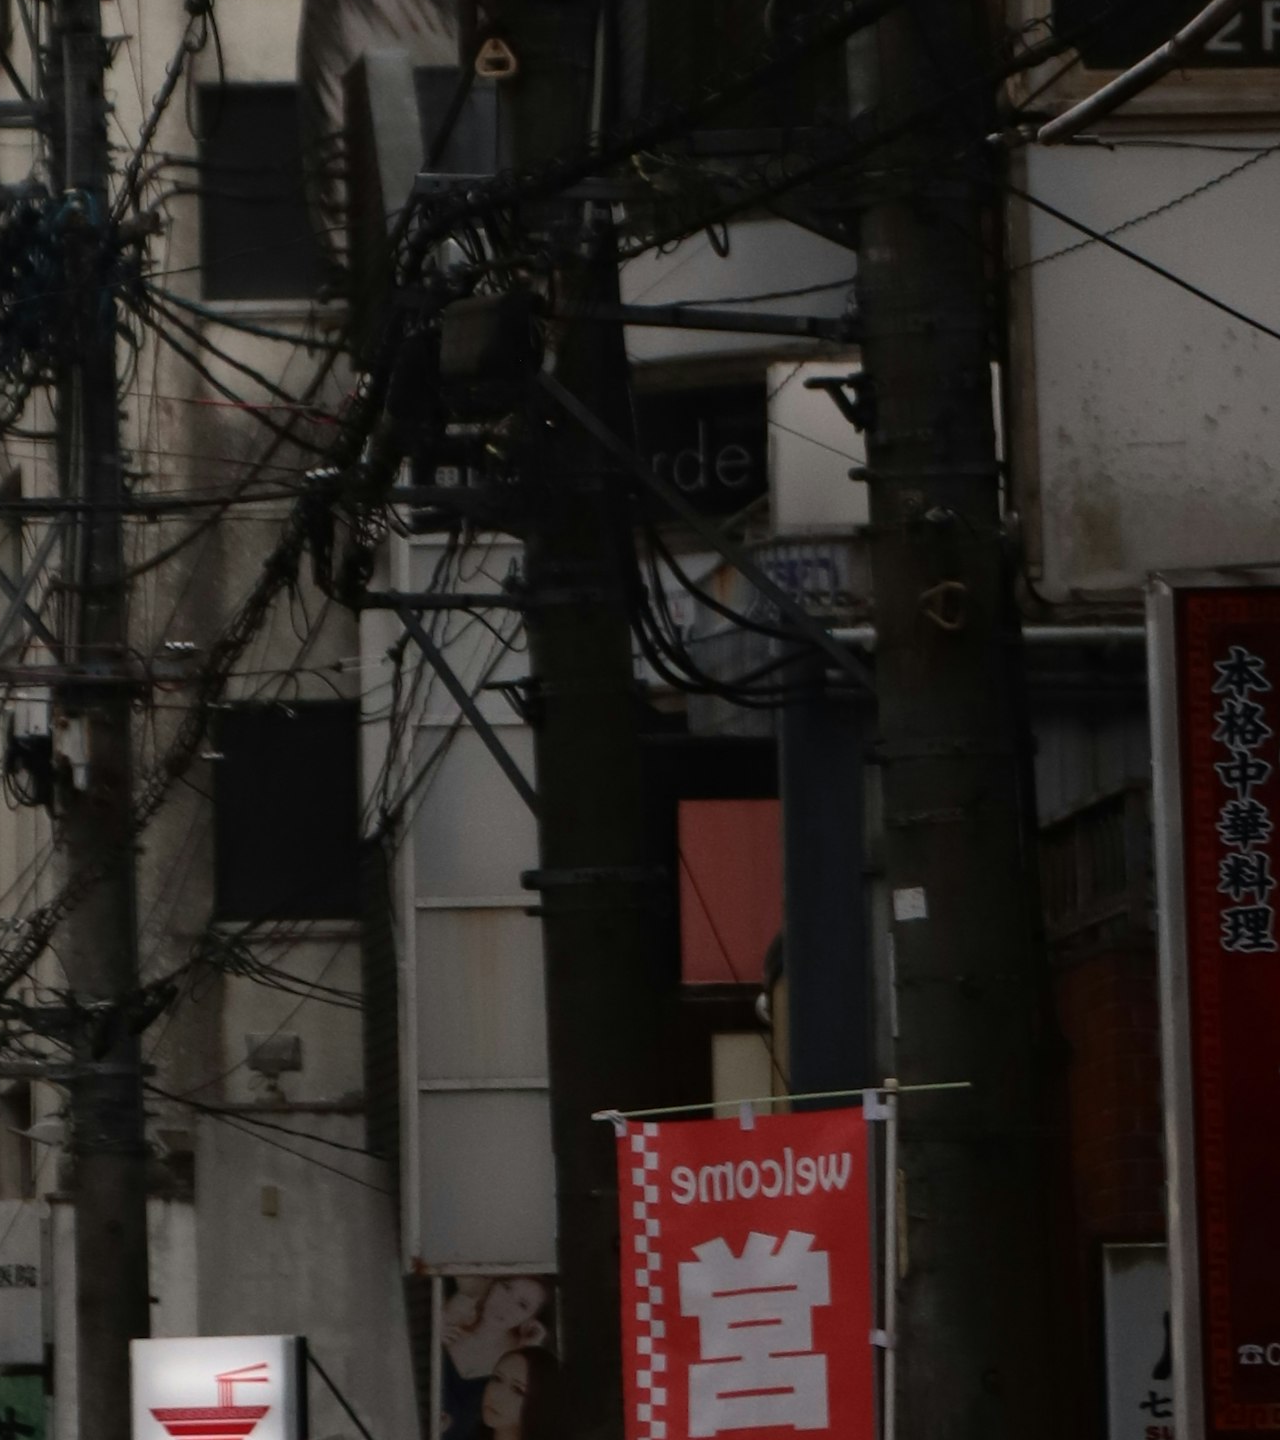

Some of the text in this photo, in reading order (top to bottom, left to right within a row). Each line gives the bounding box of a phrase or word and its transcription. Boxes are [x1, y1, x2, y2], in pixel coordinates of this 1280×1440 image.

[1211, 646, 1278, 953] 本格中華料理
